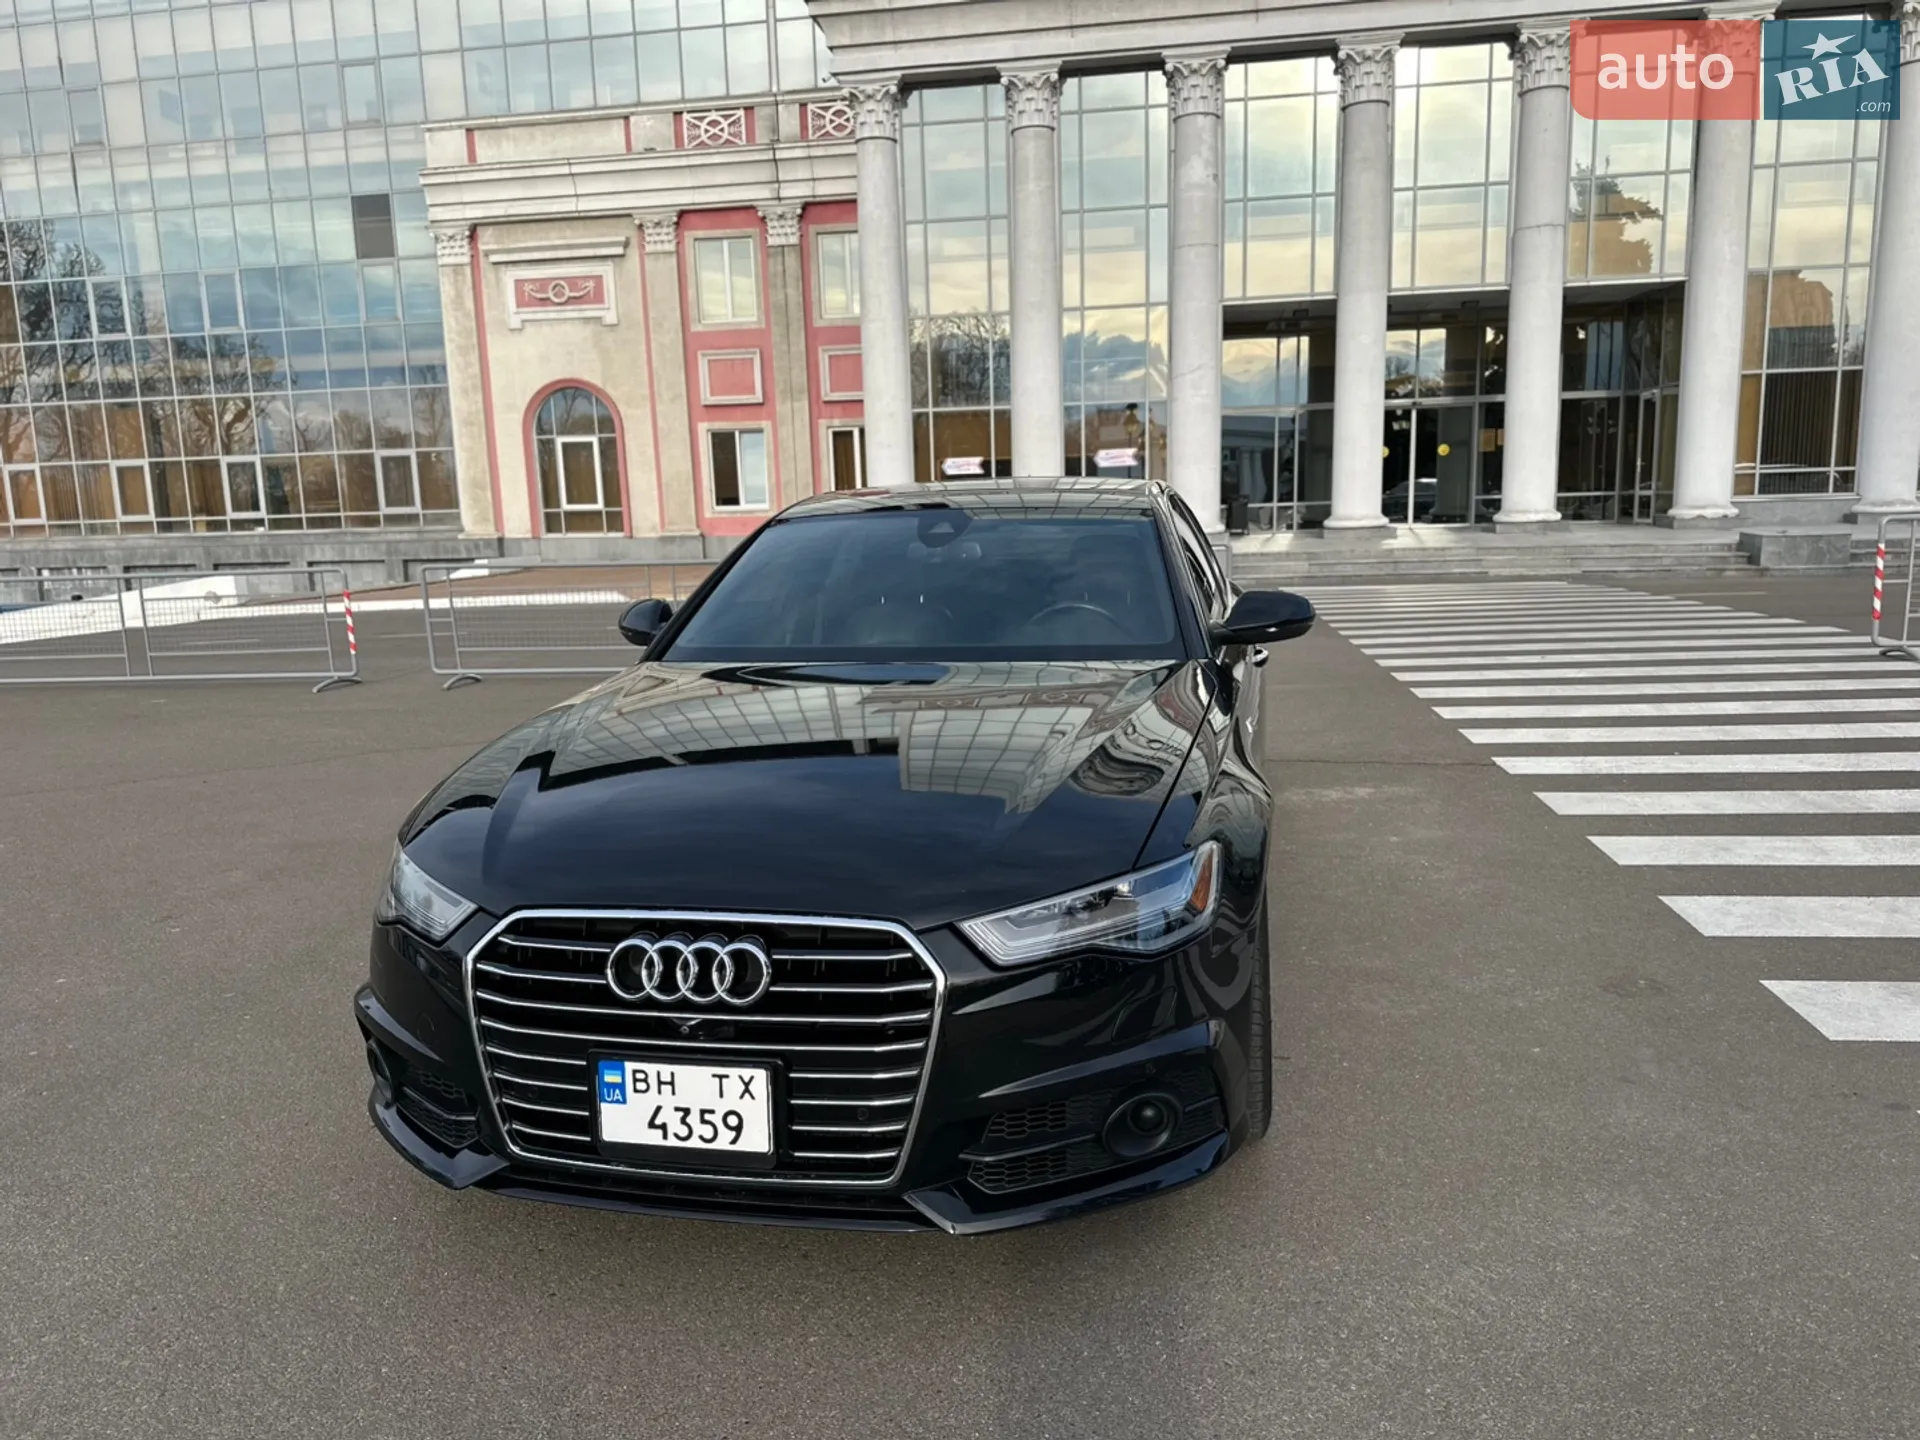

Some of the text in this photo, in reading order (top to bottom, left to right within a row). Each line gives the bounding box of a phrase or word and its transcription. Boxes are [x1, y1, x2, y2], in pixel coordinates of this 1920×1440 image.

[604, 1088, 623, 1102] UA
[632, 1069, 756, 1100] BH TX
[647, 1105, 744, 1145] 4359
